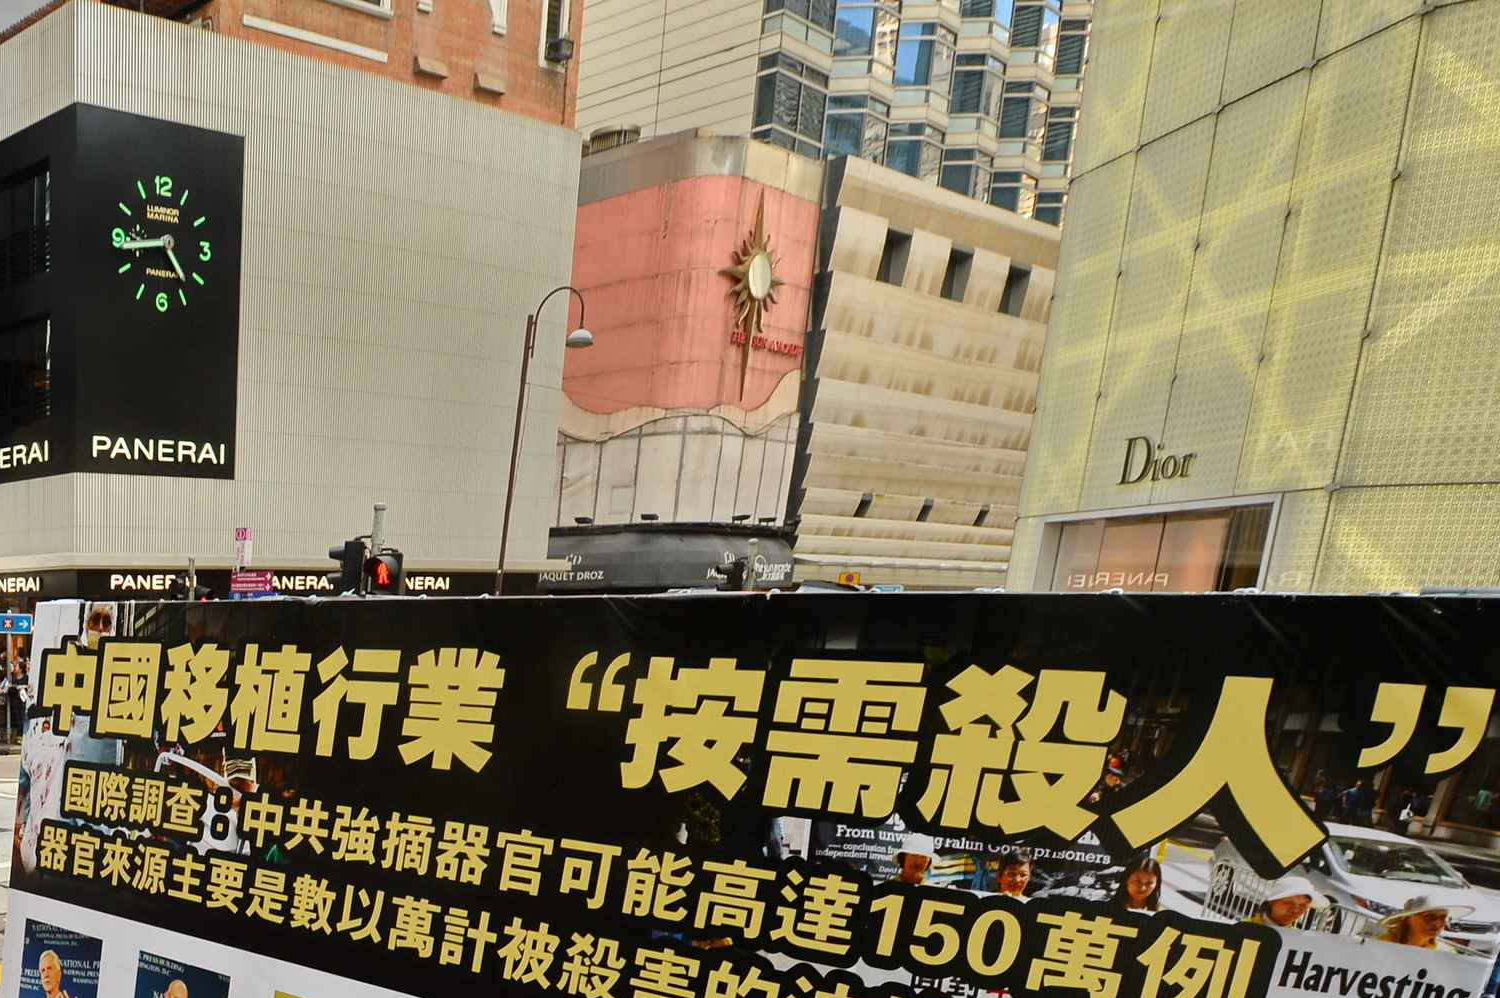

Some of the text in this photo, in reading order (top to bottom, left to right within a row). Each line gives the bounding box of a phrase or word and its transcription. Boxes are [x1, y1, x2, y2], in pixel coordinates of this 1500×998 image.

[154, 175, 173, 198] 12
[146, 204, 180, 216] LUMINOR
[146, 211, 180, 224] MARINA
[111, 227, 126, 249] 9
[199, 240, 211, 261] 3
[146, 267, 180, 279] PANERA
[155, 292, 168, 312] 6
[92, 435, 226, 465] PANERAI
[1117, 435, 1198, 486] Dior
[110, 574, 197, 590] PANERI
[272, 575, 335, 590] ANERA
[405, 576, 450, 590] NERAI
[539, 570, 604, 582] JAQUET DROZ
[41, 642, 1497, 872] 中國移植行業 “按需殺人”
[836, 824, 875, 840] From
[815, 848, 893, 861] independent invest
[843, 842, 887, 853] conclusion
[59, 959, 91, 969] NATIONAL
